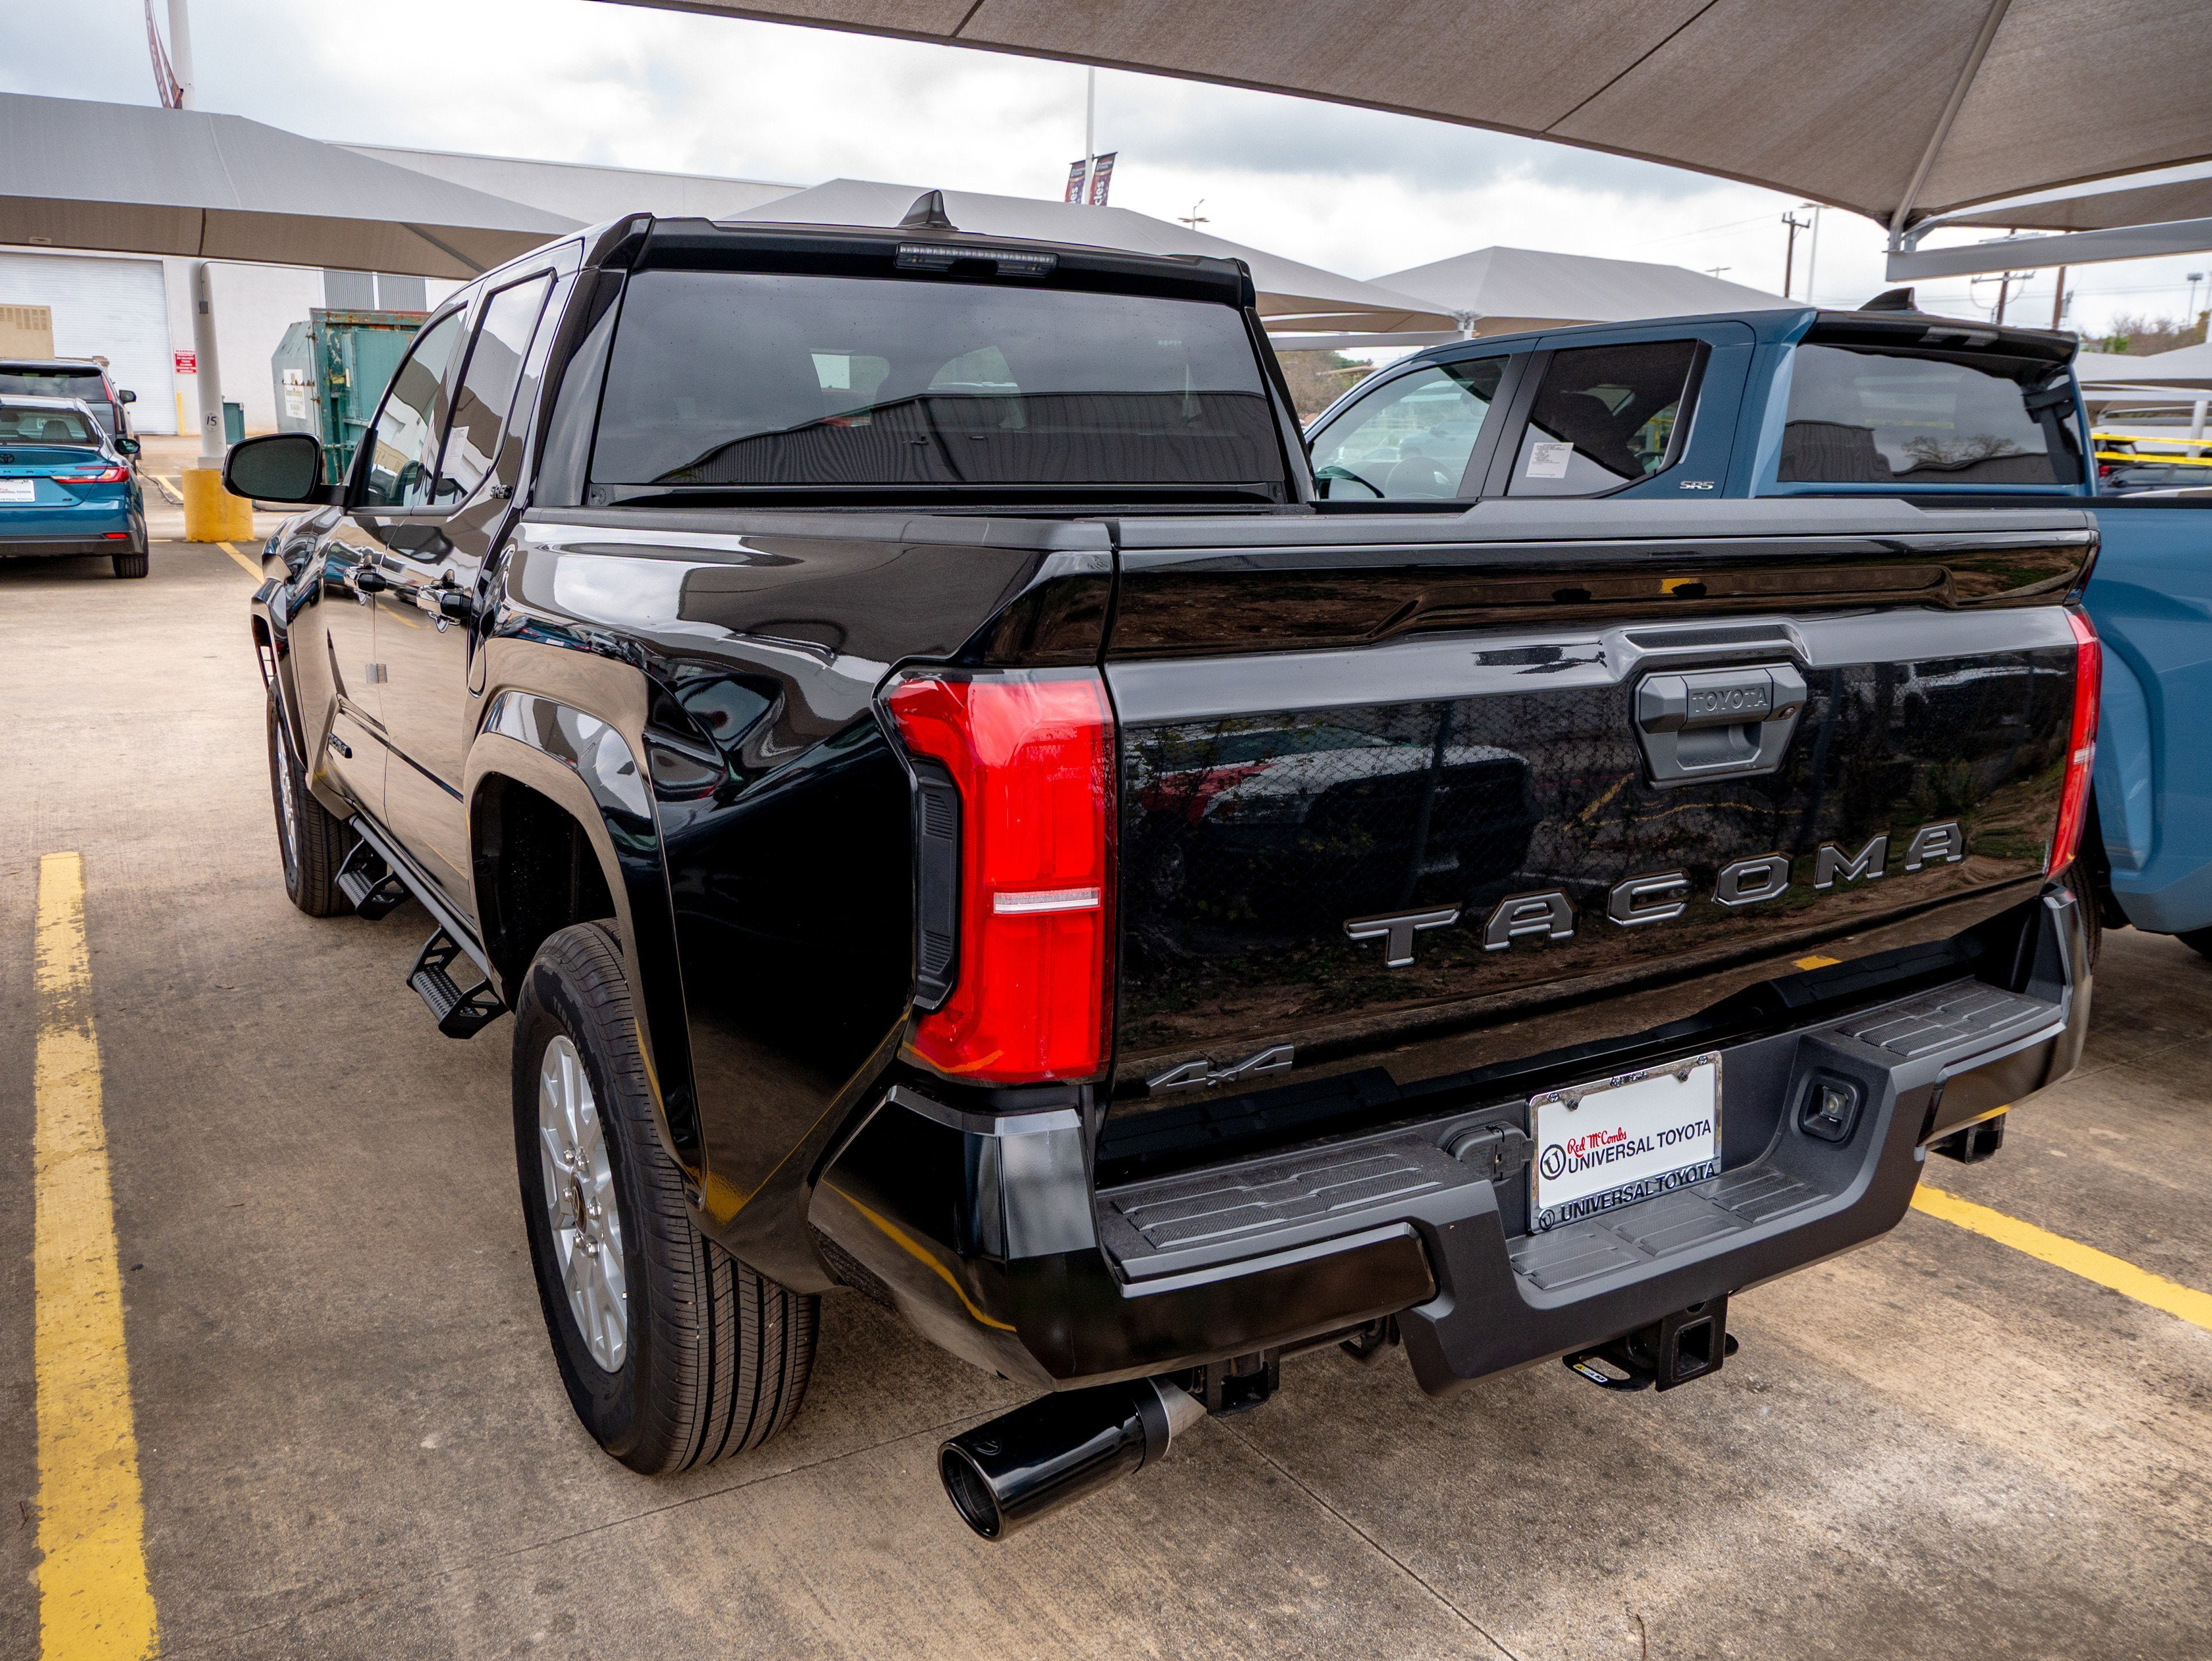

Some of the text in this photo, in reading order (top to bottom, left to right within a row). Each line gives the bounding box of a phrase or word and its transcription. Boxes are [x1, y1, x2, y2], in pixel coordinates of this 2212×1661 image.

[207, 415, 217, 426] 15
[1679, 480, 1715, 490] SR5
[1692, 687, 1767, 712] TOYOTA
[1343, 820, 1964, 968] TACOMA
[1567, 1127, 1627, 1157] Red McCombs
[1568, 1119, 1711, 1174] UNIVERSAL TOYOTA
[1560, 1161, 1717, 1222] UNIVERSAL TOYOTA
